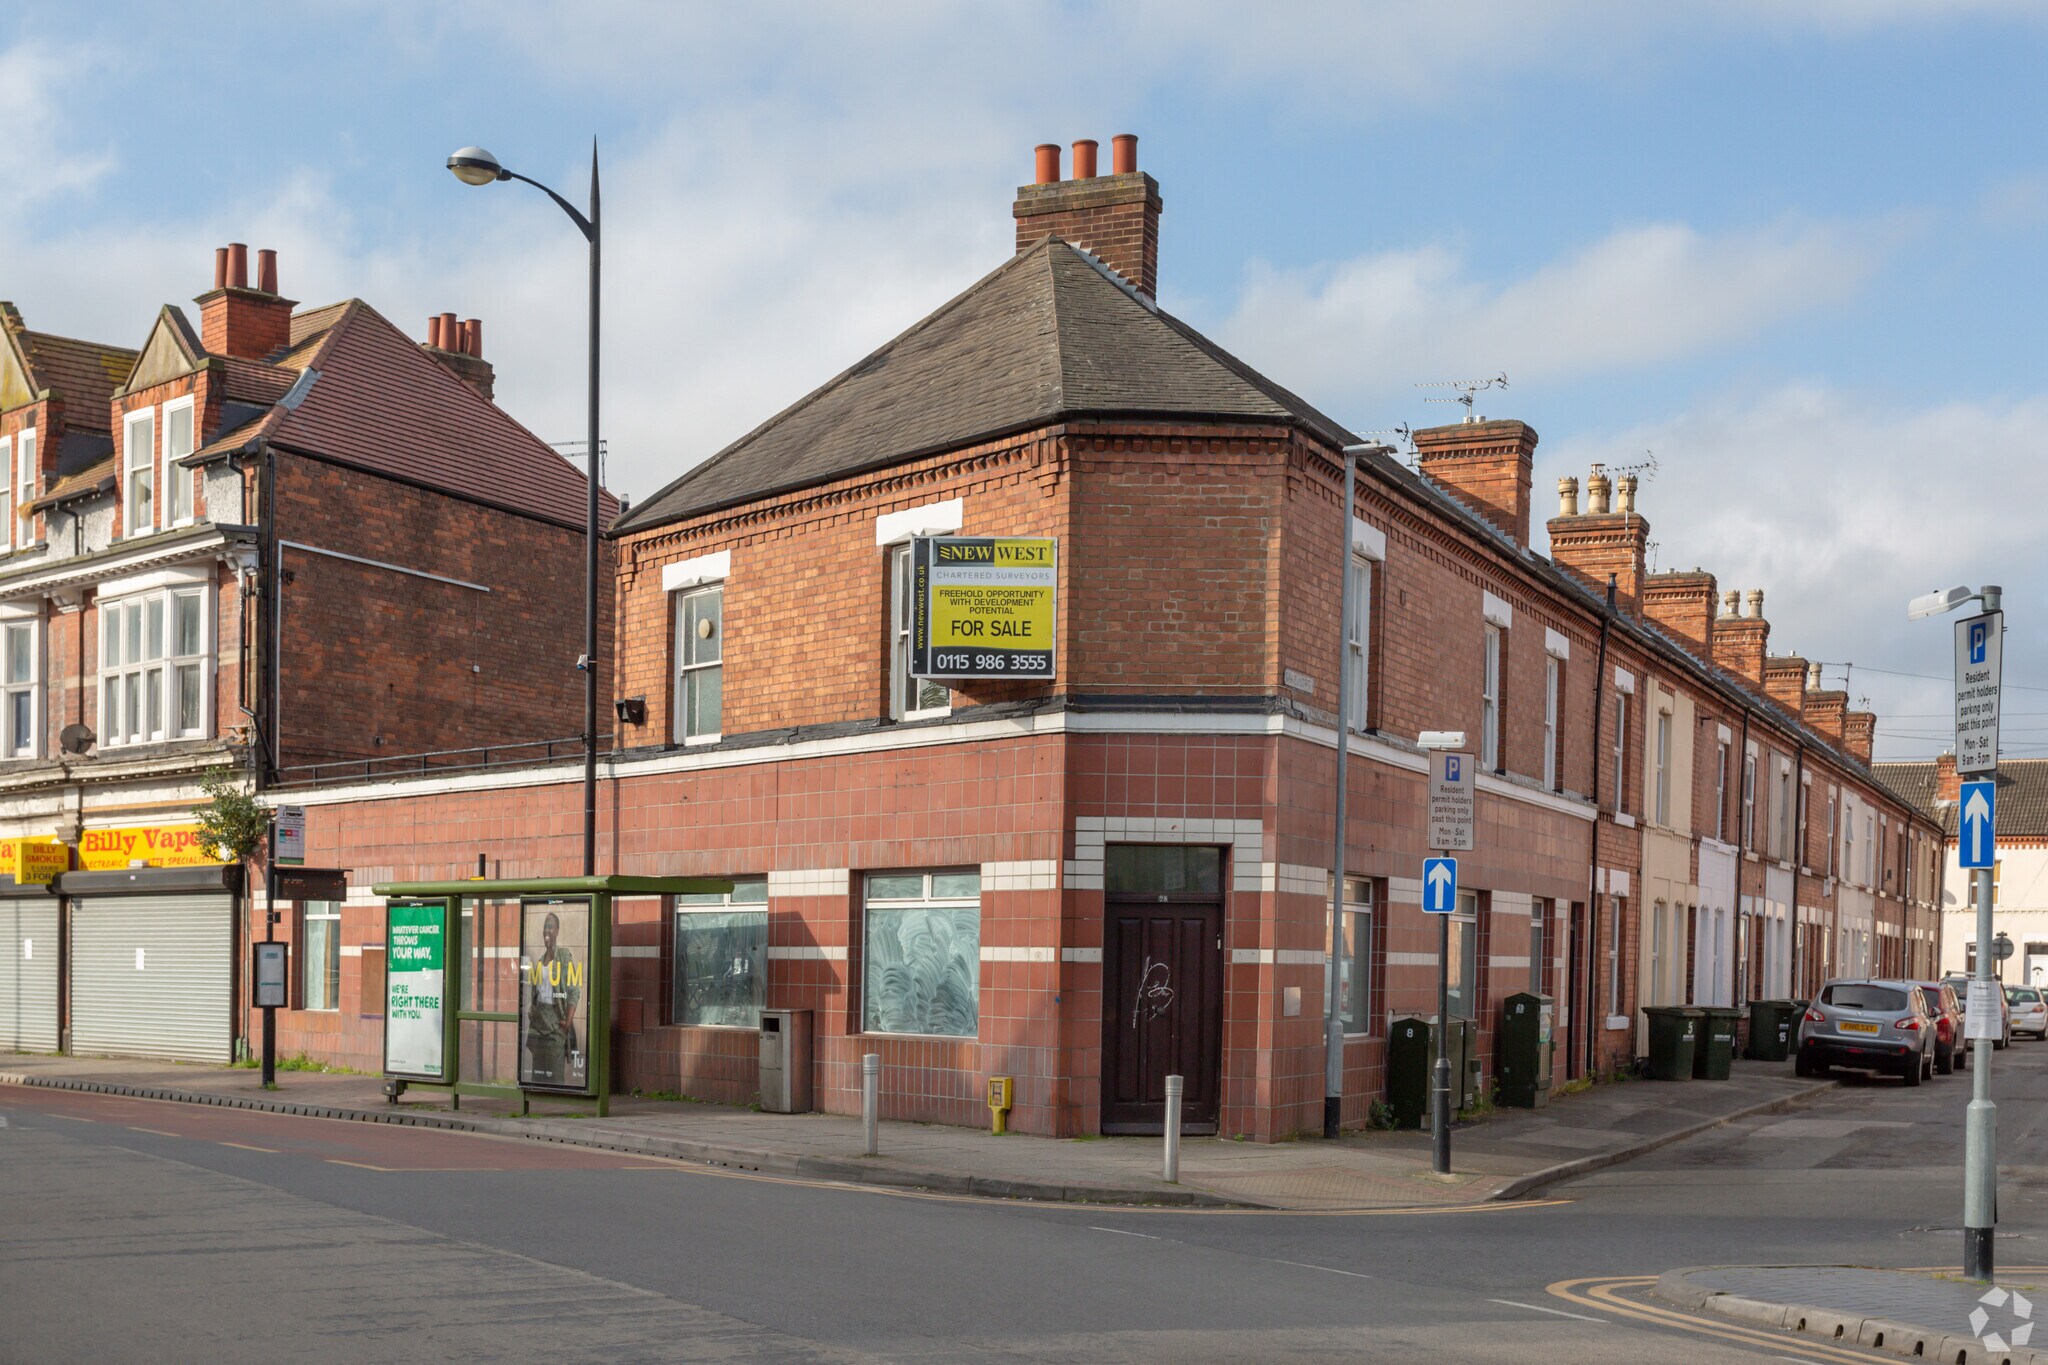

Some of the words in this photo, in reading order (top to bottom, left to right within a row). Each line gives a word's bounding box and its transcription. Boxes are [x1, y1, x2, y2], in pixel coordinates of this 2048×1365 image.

[950, 546, 993, 560] NEW
[997, 546, 1047, 561] WEST
[936, 571, 992, 579] CHARTERED
[996, 571, 1050, 580] SURVEYORS
[939, 590, 983, 598] FREEHOLD
[986, 590, 1045, 598] OPPORTUNITY
[917, 565, 925, 649] www.newwest.co.uk
[951, 620, 984, 636] FOR
[990, 620, 1032, 637] SALE
[1974, 628, 1984, 660] P
[937, 654, 969, 669] 0115
[975, 654, 1005, 670] 986
[1011, 655, 1047, 670] 3555
[1965, 670, 1990, 684] Resident
[1958, 688, 1976, 703] permit
[1976, 685, 1997, 697] holders
[1960, 703, 1981, 718] parking
[1982, 701, 1994, 714] only
[1958, 721, 1969, 734] past
[1970, 718, 1981, 730] this
[1982, 717, 1997, 730] point
[1964, 739, 1975, 749] Mon
[1979, 736, 1989, 748] Sat
[1448, 758, 1458, 779] P
[1440, 785, 1464, 794] Resident
[1452, 796, 1472, 805] holders
[1434, 806, 1455, 815] parking
[1457, 807, 1469, 815] only
[1457, 816, 1472, 824] point
[1439, 827, 1451, 835] Mon
[1455, 827, 1465, 836] Sat
[33, 845, 57, 853] BILLY
[85, 831, 136, 856] Billy
[143, 829, 214, 853] Vape
[25, 855, 65, 863] SMOKES
[80, 859, 123, 869] ELECTRONIC
[25, 872, 31, 880] 3
[33, 872, 52, 880] FOR
[392, 925, 419, 934] WHATEVER
[420, 925, 439, 934] CANCER
[393, 935, 418, 945] THROWS
[392, 946, 413, 959] YOUR
[413, 946, 432, 960] WAY,
[527, 961, 583, 987] MUM
[392, 984, 409, 994] WE'RE
[391, 995, 413, 1008] RIGHT
[414, 996, 439, 1009] THERE
[392, 1009, 407, 1019] WITH
[408, 1010, 422, 1019] YOU.
[1406, 1028, 1414, 1038] 8
[1687, 1021, 1694, 1034] 5
[571, 1050, 584, 1069] Tu
[992, 1083, 1003, 1102] H
